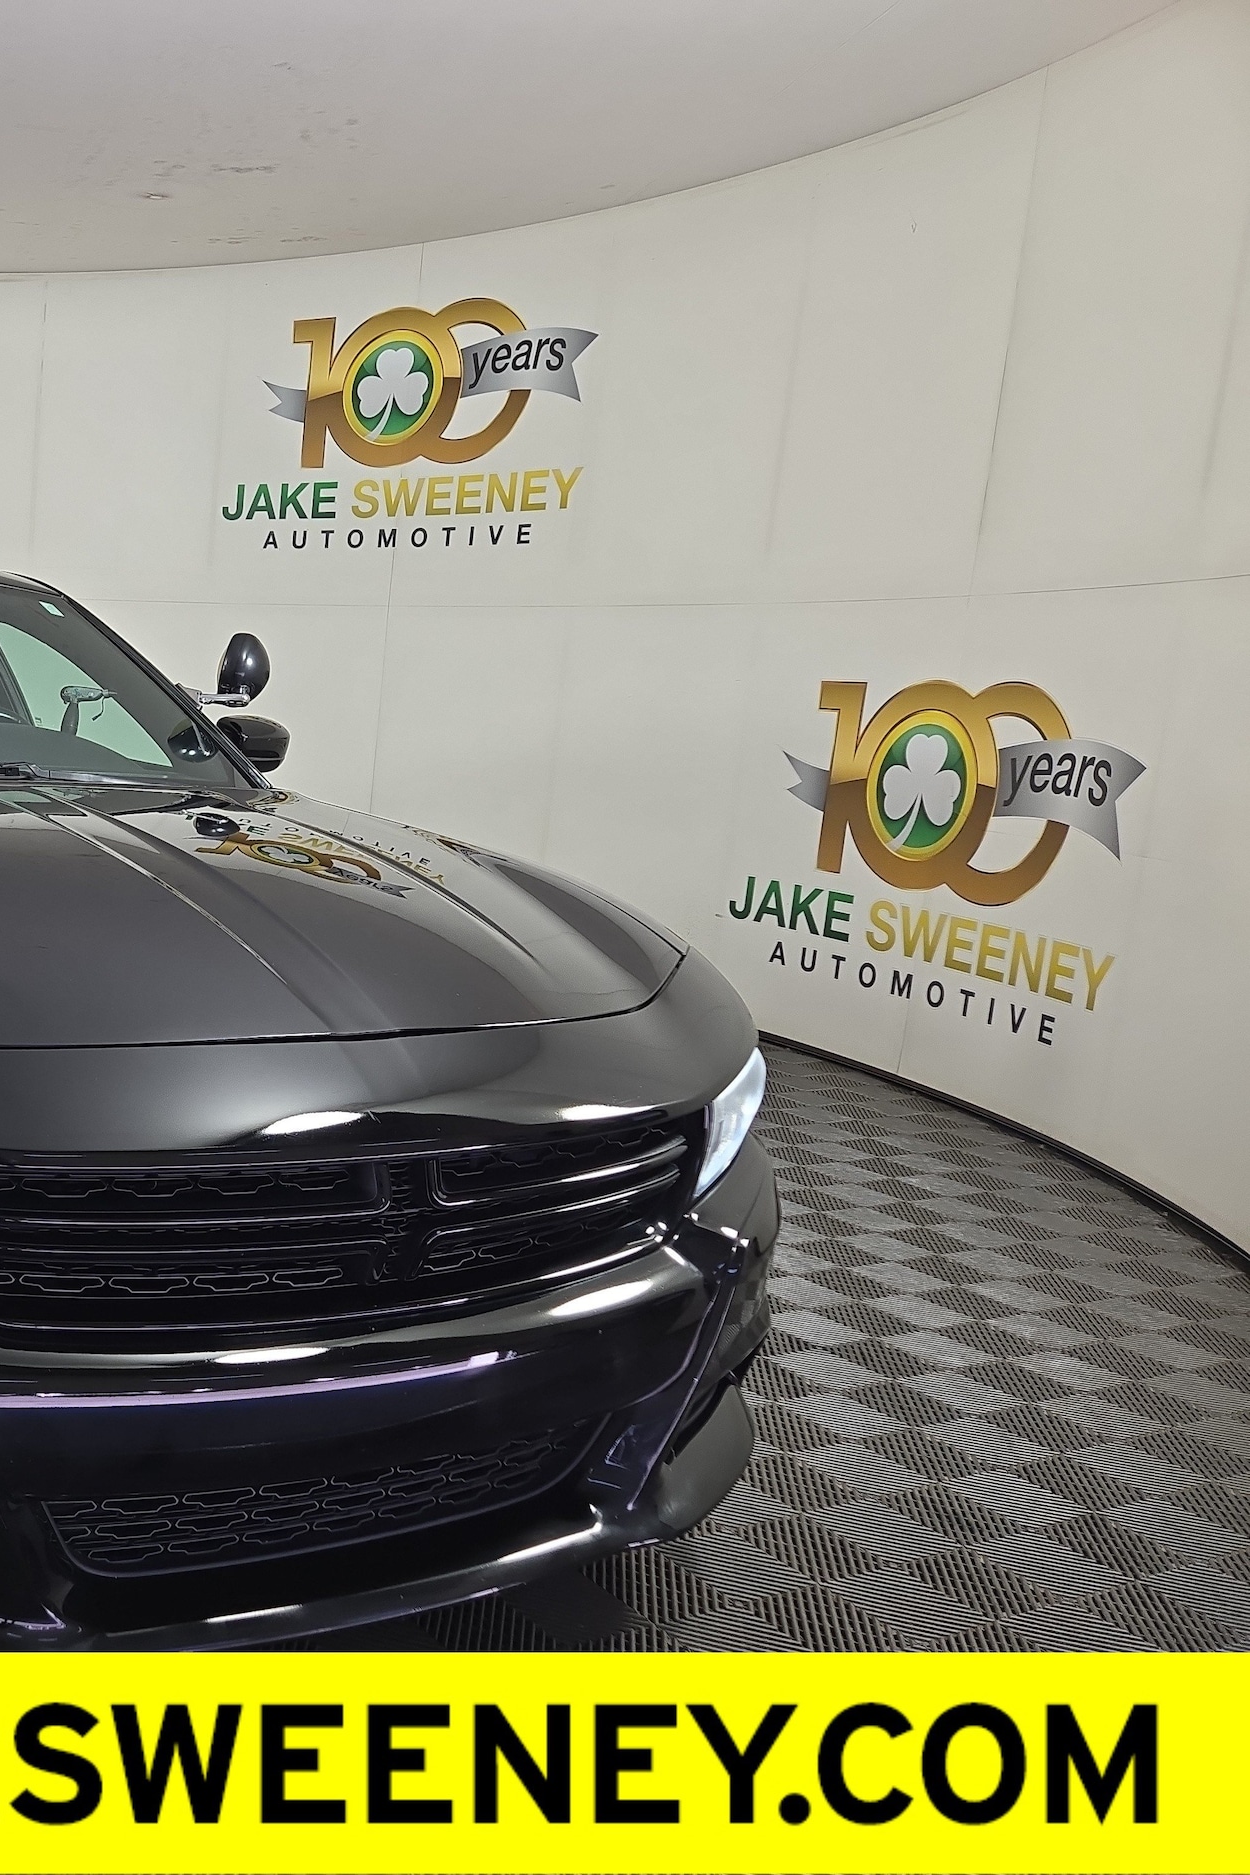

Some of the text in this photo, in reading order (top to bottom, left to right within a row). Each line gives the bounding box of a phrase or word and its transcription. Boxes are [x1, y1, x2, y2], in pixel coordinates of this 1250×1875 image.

[469, 336, 566, 389] years
[222, 467, 584, 521] JAKE SWEENEY
[263, 523, 532, 550] AUTOMOTIVE
[1003, 751, 1113, 807] years
[729, 876, 1115, 1011] JAKE SWEENEY
[769, 941, 1056, 1046] AUTOMOTIVE
